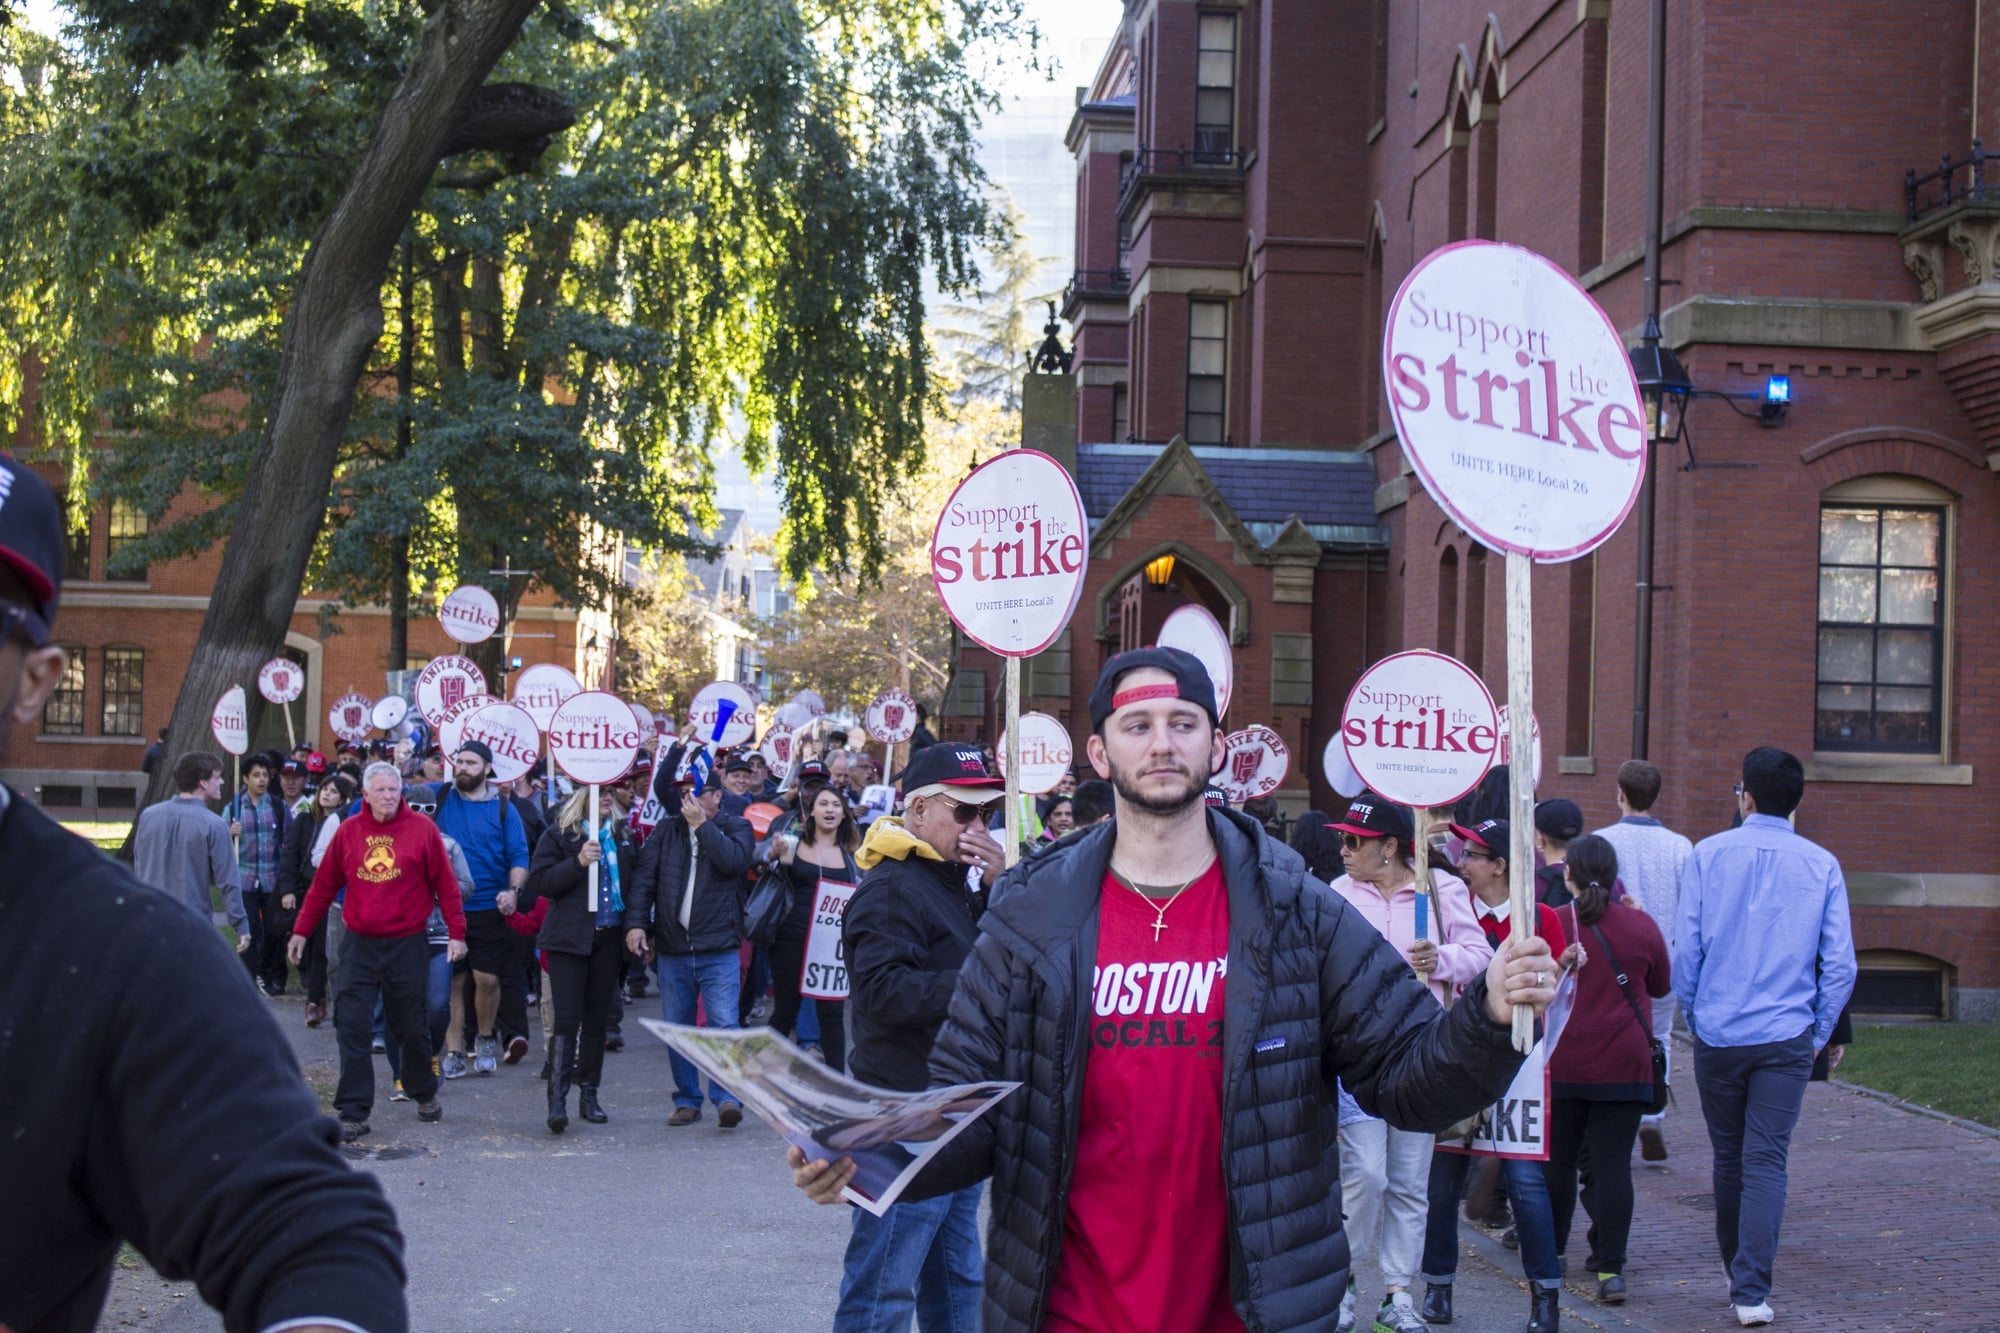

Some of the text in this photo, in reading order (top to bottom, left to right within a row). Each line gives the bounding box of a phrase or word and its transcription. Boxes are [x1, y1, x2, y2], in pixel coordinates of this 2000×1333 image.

[1409, 290, 1551, 356] Support
[1569, 365, 1609, 398] the
[1392, 351, 1642, 460] strike
[1450, 452, 1589, 494] UNITE HERE Local 26
[951, 502, 1039, 533] Support
[1047, 517, 1067, 536] the
[935, 519, 1083, 583] strike
[975, 600, 1003, 611] UNITE
[1003, 599, 1024, 609] HERE
[1025, 597, 1045, 608] Local
[441, 606, 498, 629] strike
[422, 658, 454, 685] UNITE
[511, 688, 569, 709] strik
[1358, 685, 1442, 712] Support
[444, 697, 480, 725] UNITE
[557, 712, 608, 727] Support
[688, 710, 755, 726] strke
[1452, 709, 1477, 724] the
[550, 723, 639, 750] strike
[1225, 733, 1254, 751] NITE
[1345, 708, 1496, 754] strike
[461, 727, 538, 765] strike
[997, 743, 1070, 765] srike
[1376, 762, 1458, 775] UNITE HERE Local 26
[1204, 791, 1224, 799] NITE
[1259, 777, 1277, 791] 26
[820, 895, 849, 915] BOS
[816, 915, 843, 927] LOC
[1091, 1020, 1225, 1049] OCAL 2
